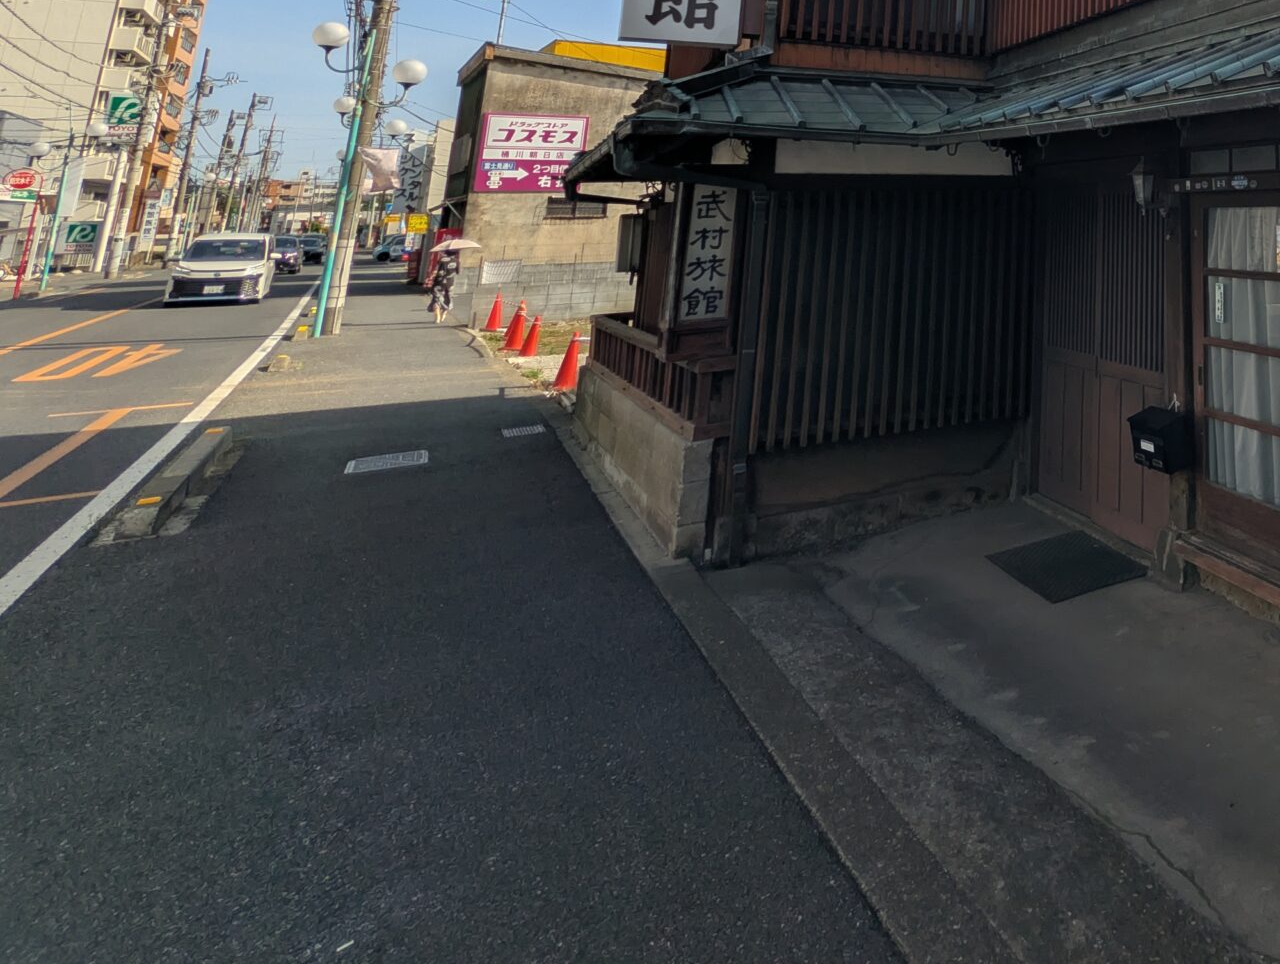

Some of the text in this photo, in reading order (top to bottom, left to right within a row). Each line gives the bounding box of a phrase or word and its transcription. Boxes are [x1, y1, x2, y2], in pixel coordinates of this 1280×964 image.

[492, 128, 579, 145] コスモス
[509, 121, 569, 129] ドラッグストア
[682, 190, 733, 317] 武村旅館
[11, 343, 184, 382] 40
